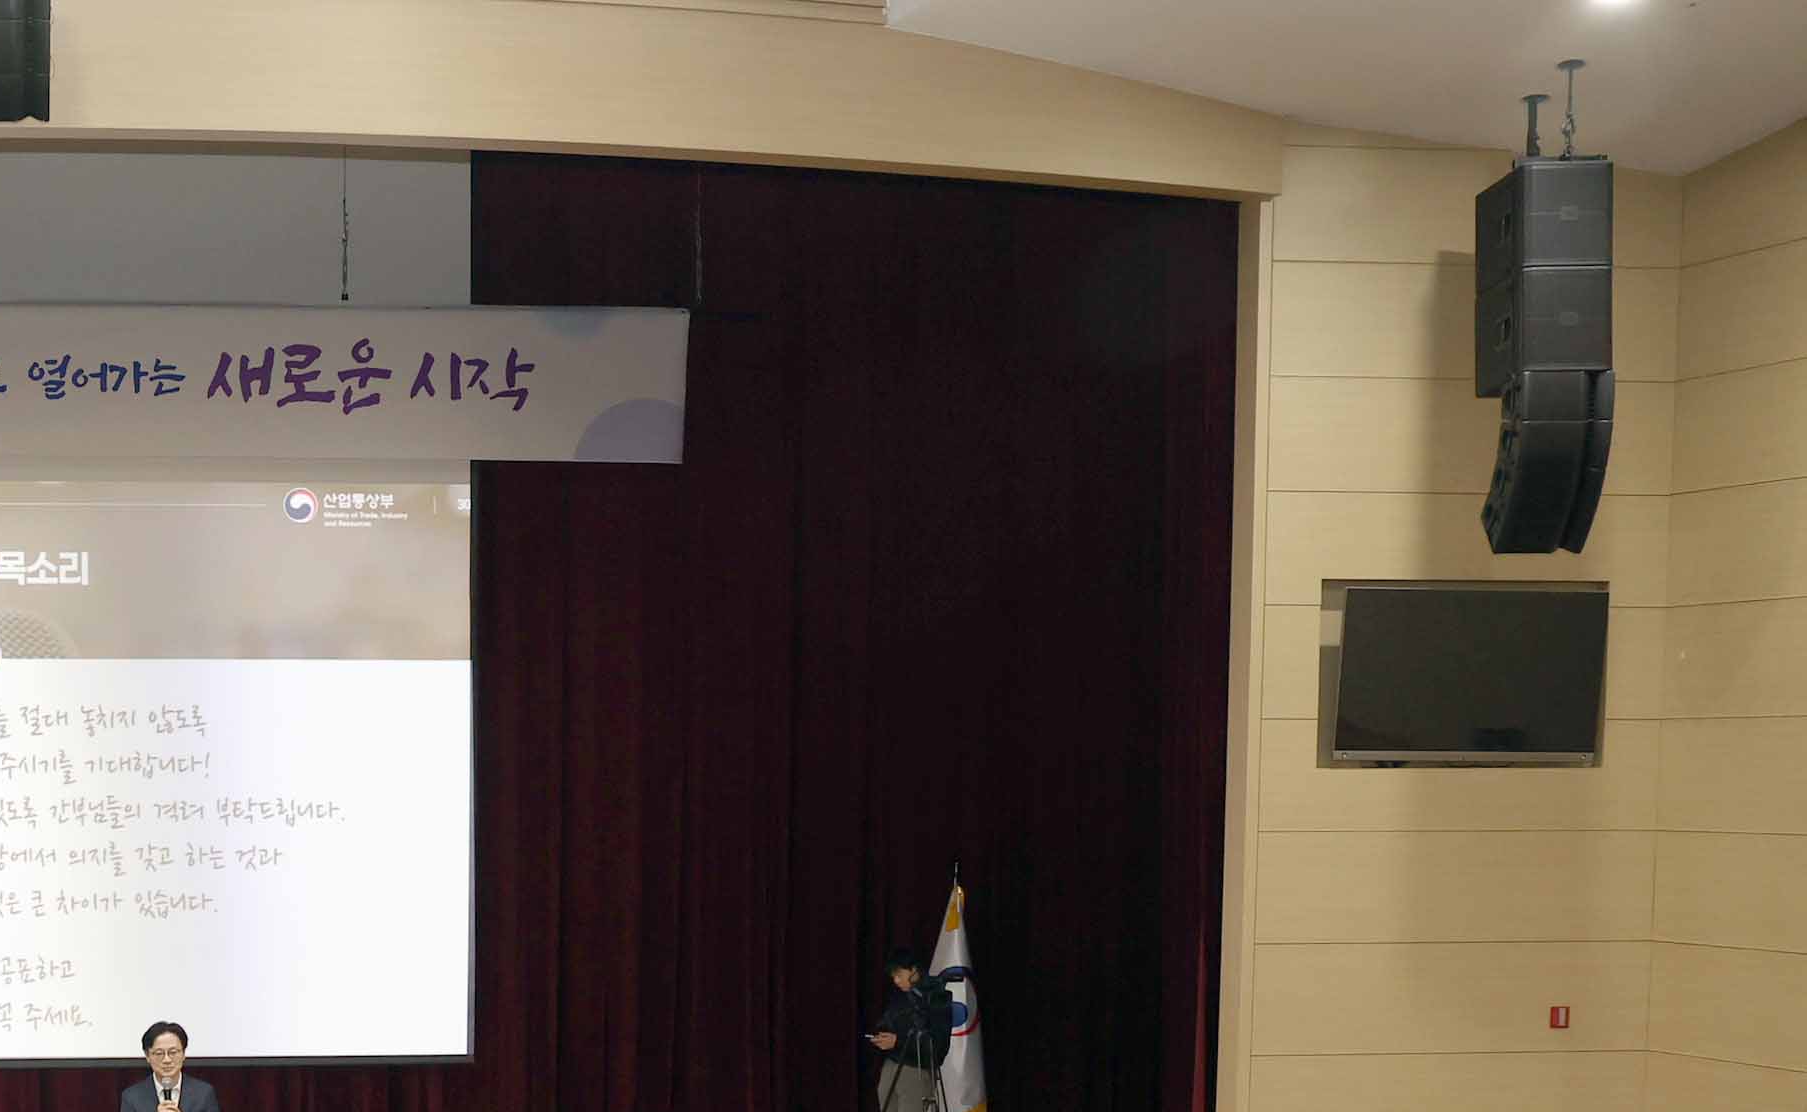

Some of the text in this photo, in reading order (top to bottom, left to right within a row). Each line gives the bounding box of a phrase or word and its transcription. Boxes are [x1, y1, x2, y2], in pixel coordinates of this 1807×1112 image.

[27, 354, 186, 400] 열어가는
[206, 337, 393, 416] 새로운
[409, 347, 536, 412] 시작
[323, 493, 395, 510] 산업통상부
[19, 704, 69, 737] 절대
[80, 703, 136, 738] 놓치지
[148, 703, 207, 737] 않도록
[84, 750, 211, 780] 기대합니다!
[49, 794, 141, 830] 간부님들의
[153, 800, 205, 823] 격려
[215, 795, 345, 828] 부탁드립니다.
[68, 840, 127, 878] 의지를
[134, 843, 174, 873] 갖고
[185, 841, 226, 870] 하는
[234, 845, 283, 871] 것과
[31, 889, 46, 918] 큰
[56, 889, 123, 915] 차이가
[134, 889, 219, 920] 있습니다.
[23, 1003, 93, 1031] 주세요.
